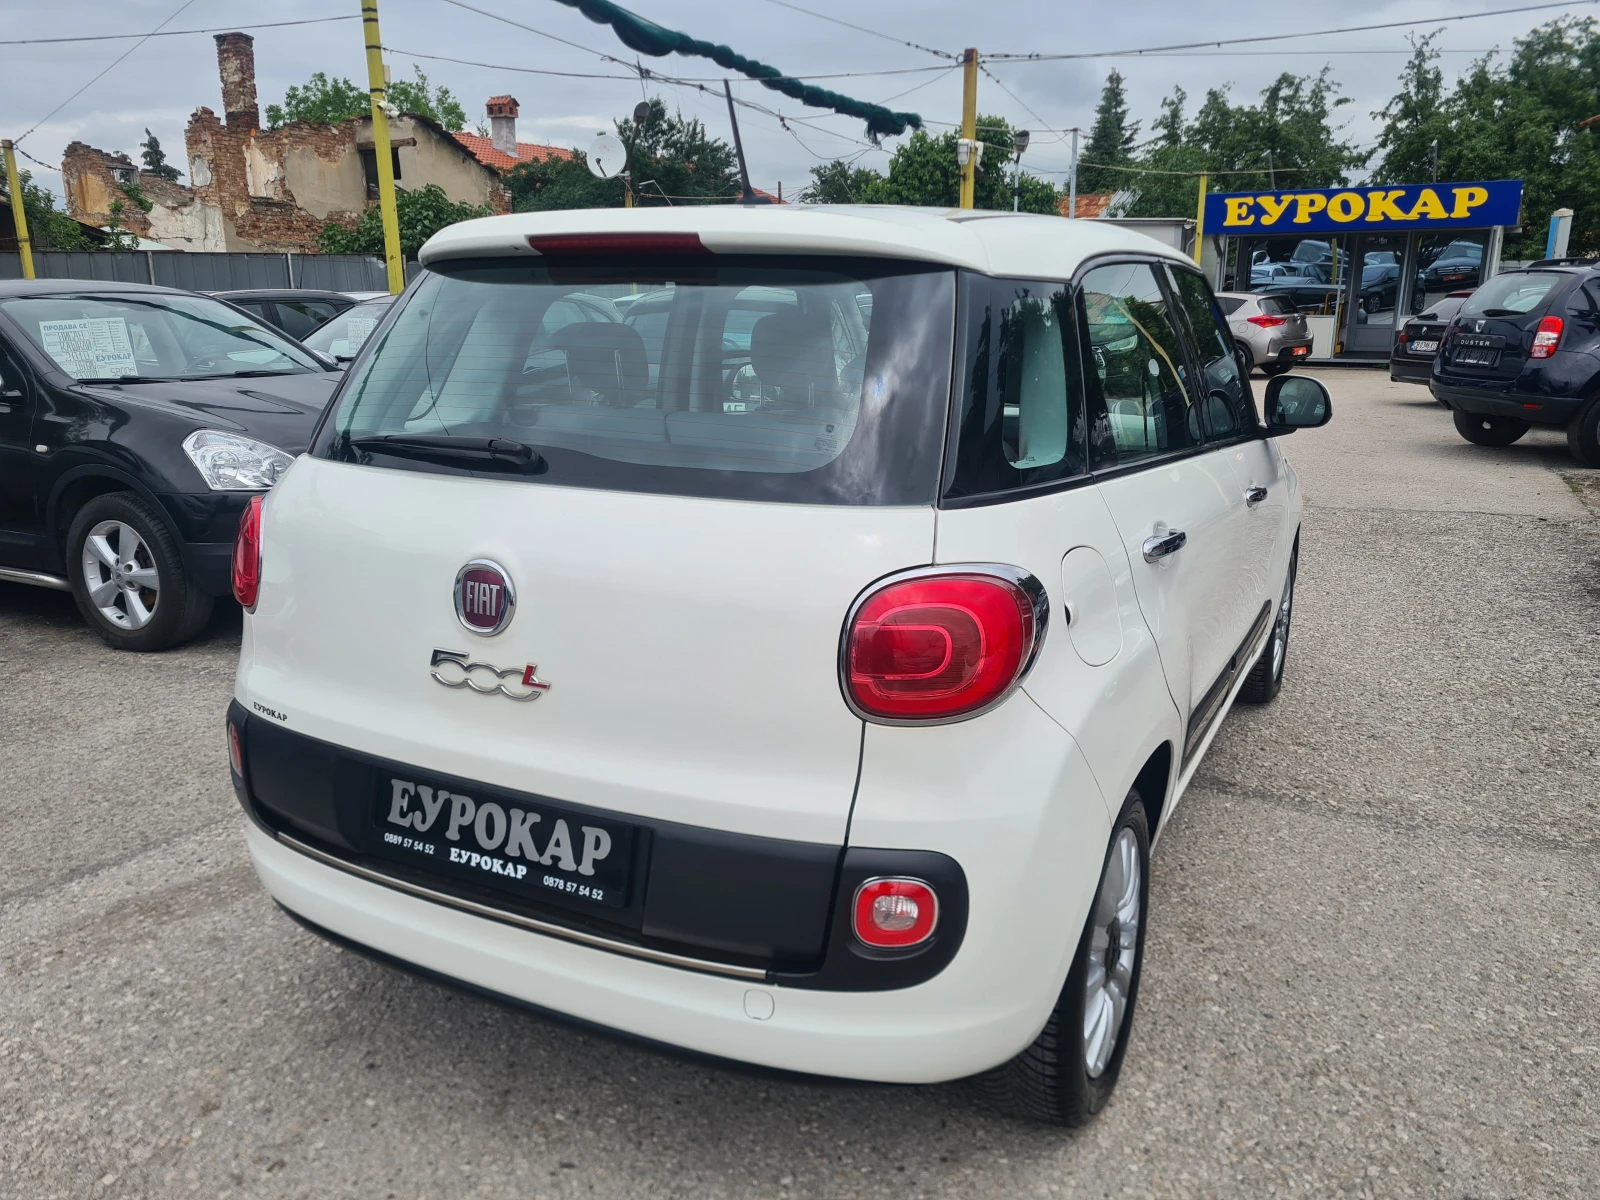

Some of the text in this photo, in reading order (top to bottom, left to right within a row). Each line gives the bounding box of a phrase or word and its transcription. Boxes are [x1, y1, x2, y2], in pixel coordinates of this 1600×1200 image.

[1222, 186, 1489, 226] ЕУРОКАР
[43, 323, 77, 332] ПРОДАВА
[1460, 339, 1491, 347] DUSTER
[65, 351, 90, 362] 2010
[95, 352, 132, 363] ЕУРОКАР
[466, 580, 501, 616] FIAT
[430, 646, 552, 702] 500L
[253, 701, 288, 721] ЕУРОКАР
[387, 778, 612, 876] ЕУРОКАР
[384, 832, 435, 855] 0889 57 54 52
[449, 847, 528, 880] ЕУРОКАР
[543, 875, 603, 901] 0878 57 54 52
